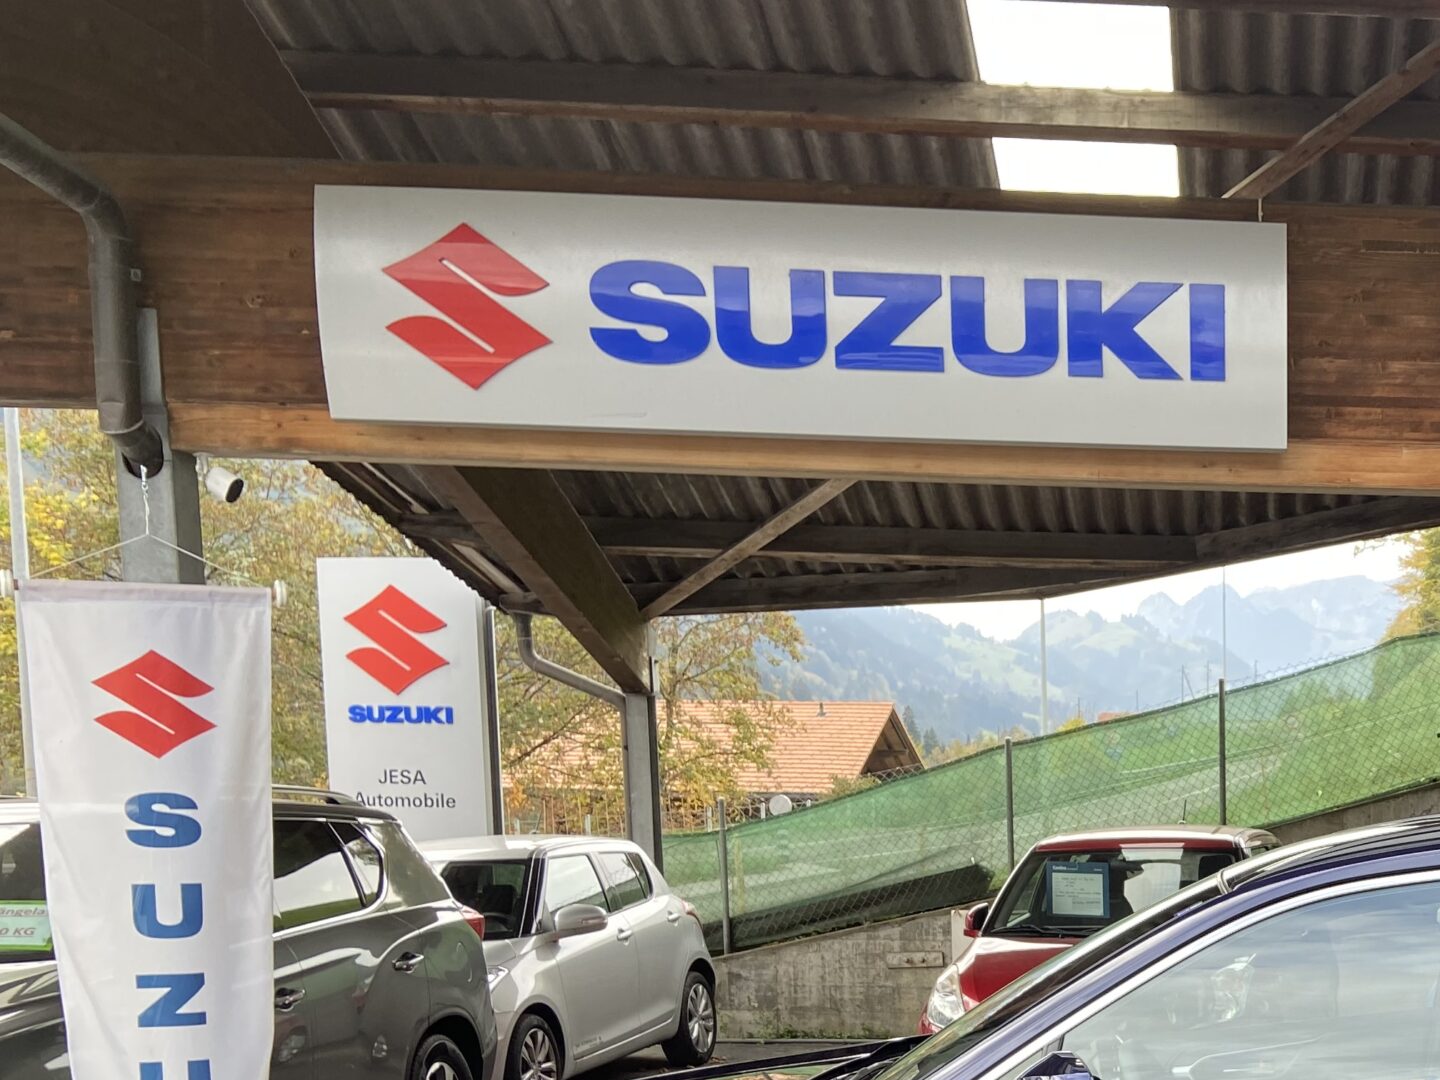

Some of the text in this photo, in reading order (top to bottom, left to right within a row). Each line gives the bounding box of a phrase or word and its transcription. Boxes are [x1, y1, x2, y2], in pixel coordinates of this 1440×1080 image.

[587, 258, 1227, 382] SUZUKI
[347, 704, 454, 725] SUZUKI
[378, 769, 427, 785] JESA
[355, 791, 457, 809] Automobile
